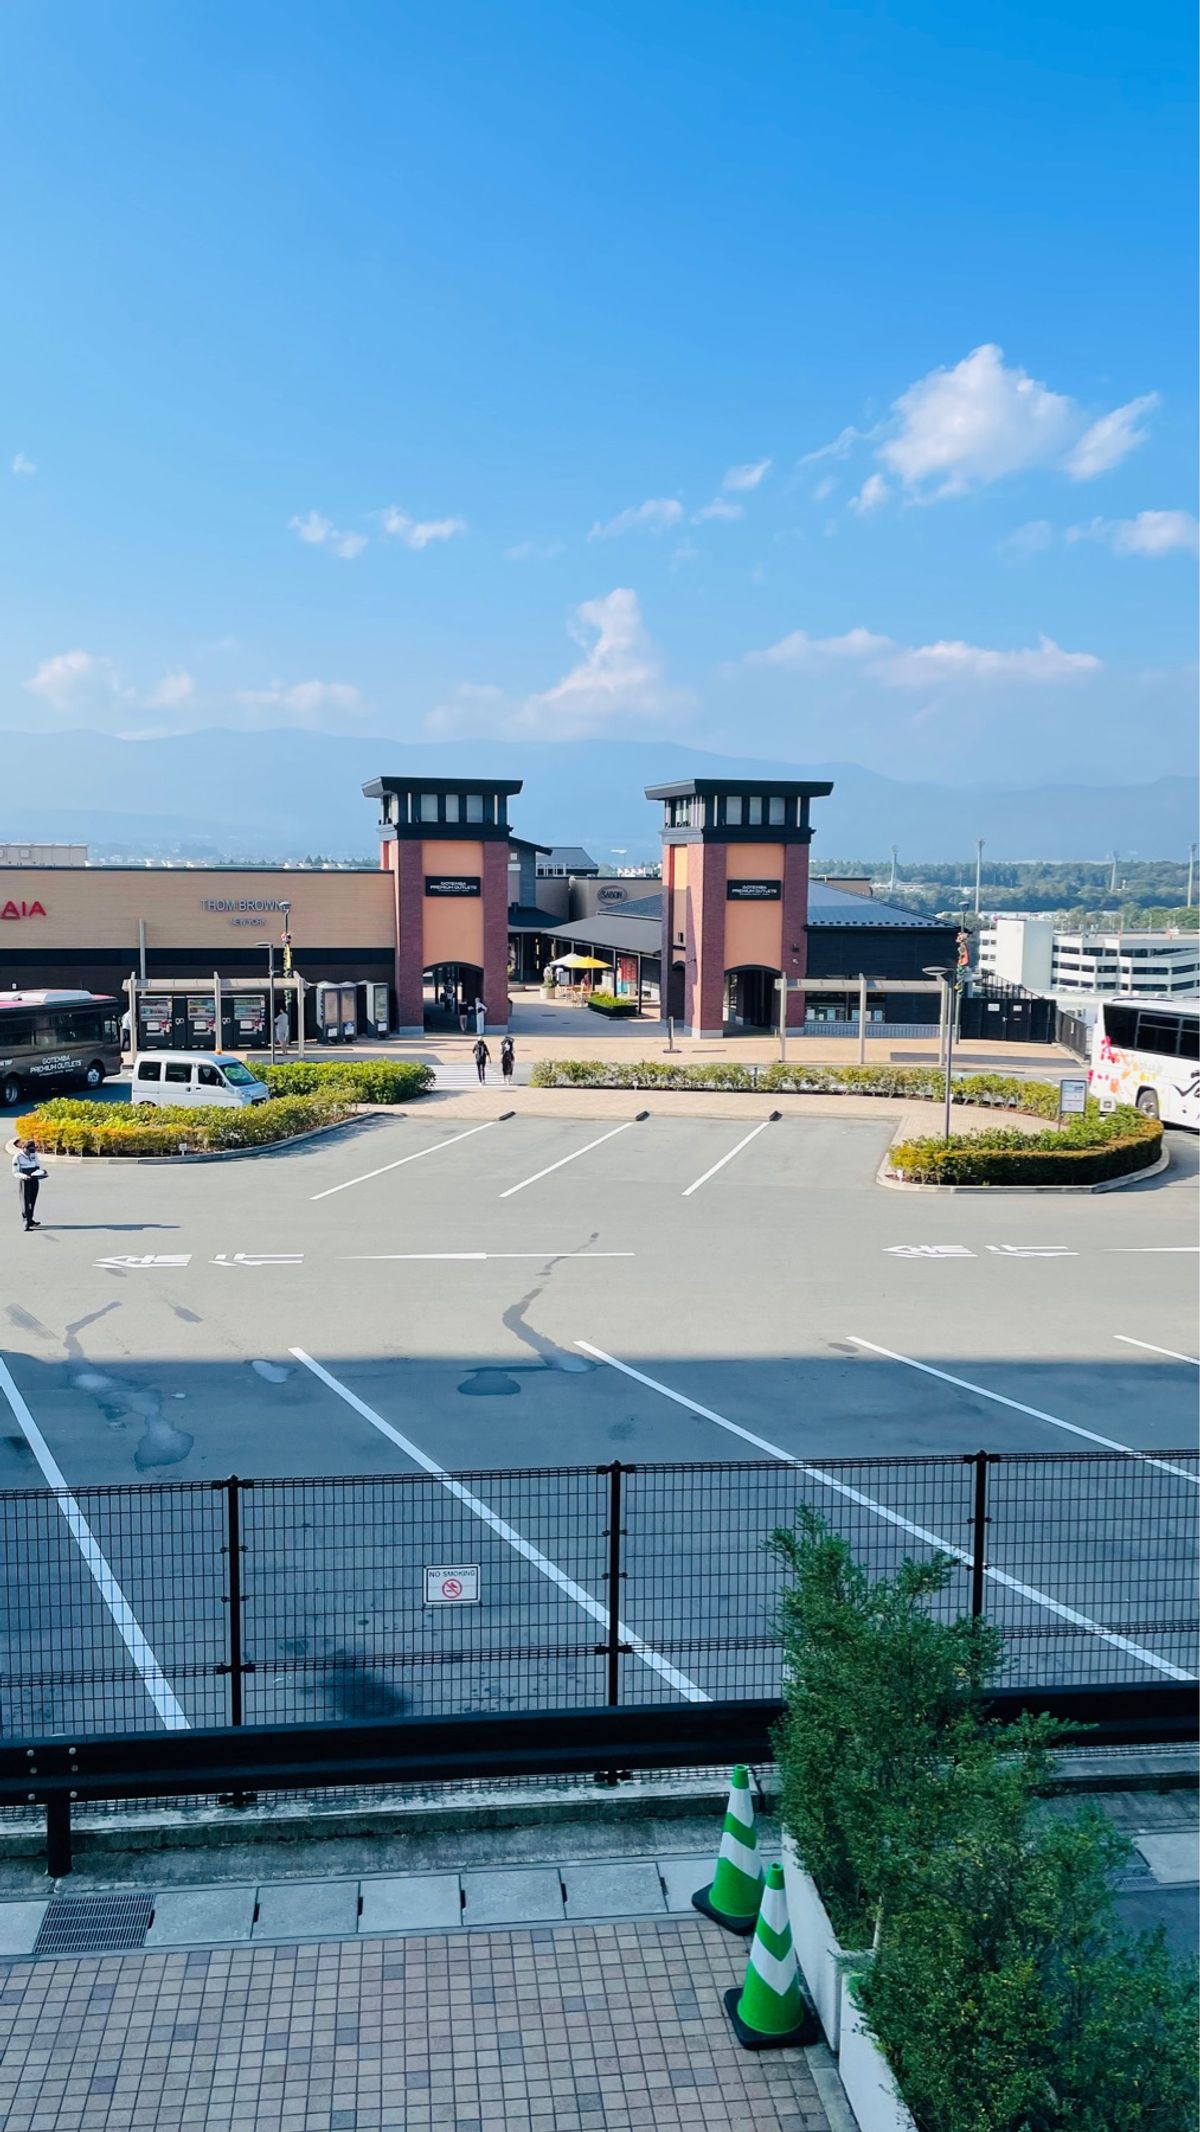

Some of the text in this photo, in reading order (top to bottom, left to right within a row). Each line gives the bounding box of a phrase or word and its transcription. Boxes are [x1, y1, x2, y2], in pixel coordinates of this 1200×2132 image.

[200, 900, 236, 911] THOM
[30, 1064, 57, 1074] PREMIUM
[57, 1059, 83, 1070] OUTLETS
[442, 1569, 475, 1577] SMOKING
